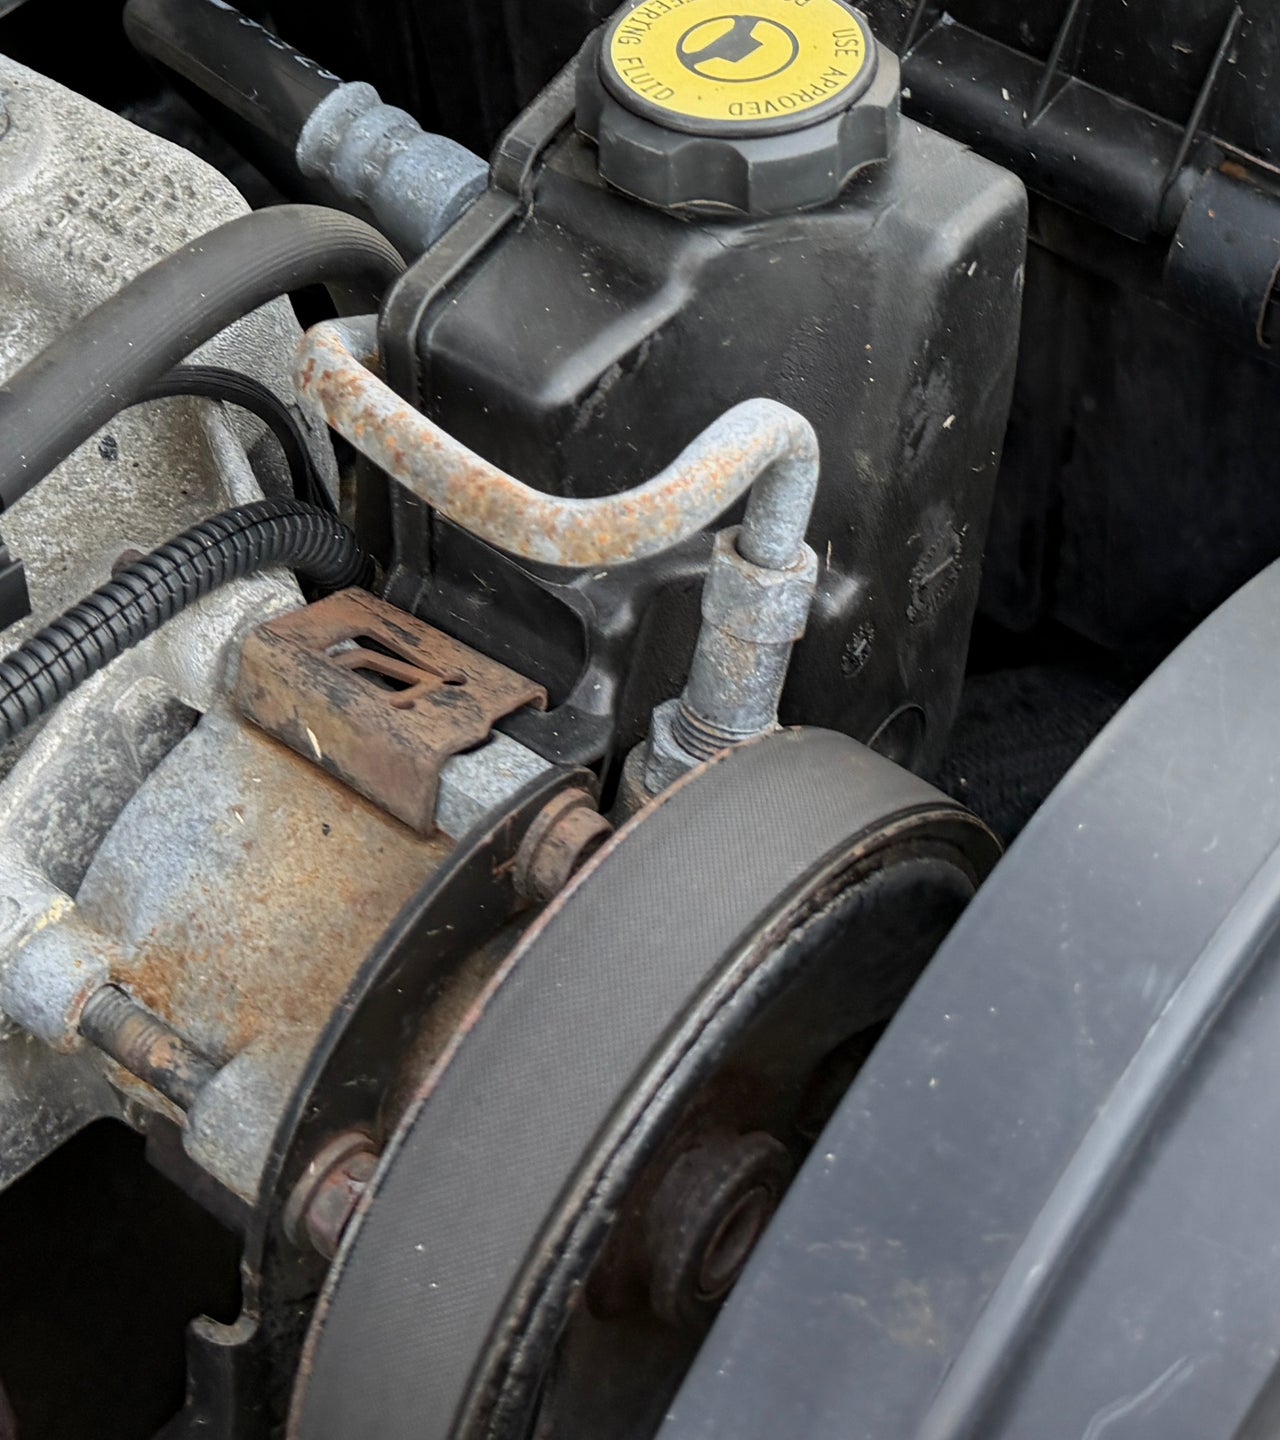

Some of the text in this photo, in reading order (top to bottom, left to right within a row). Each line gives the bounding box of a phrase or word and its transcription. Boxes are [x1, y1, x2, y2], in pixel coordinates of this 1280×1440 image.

[616, 56, 676, 102] FLUID
[728, 27, 859, 117] USE APPROVED
